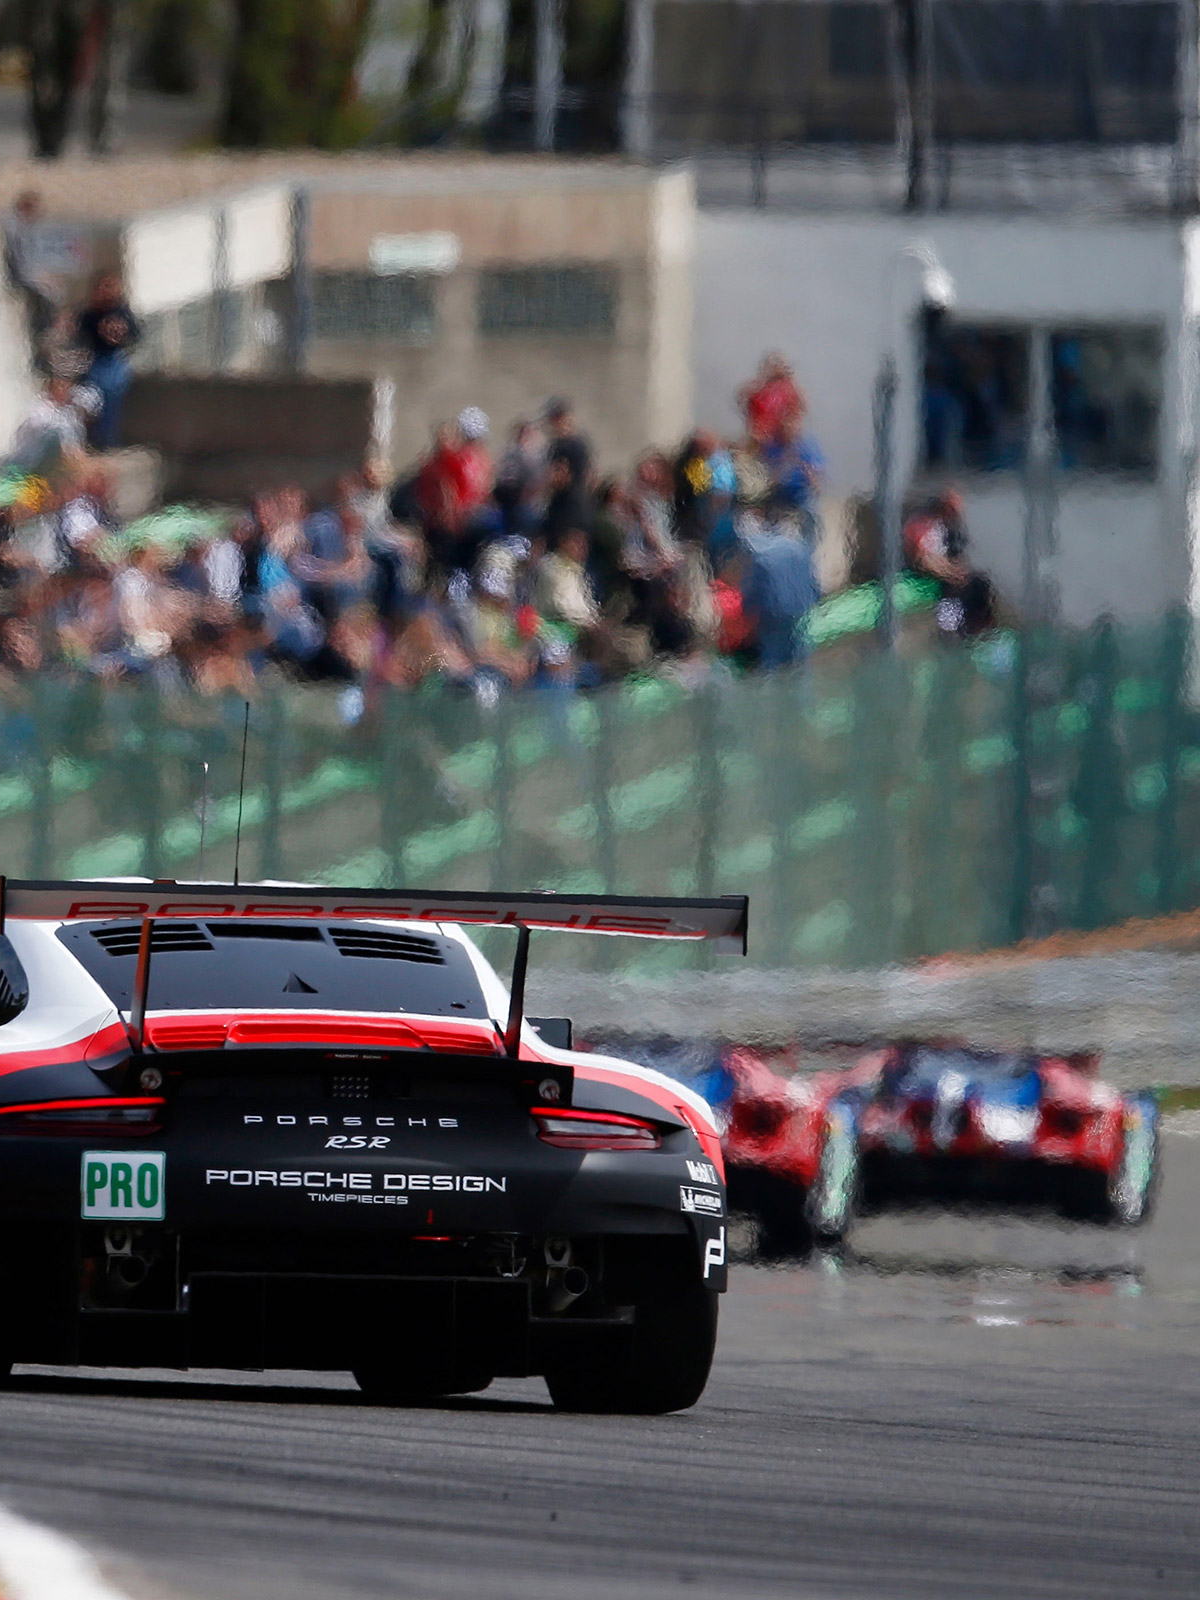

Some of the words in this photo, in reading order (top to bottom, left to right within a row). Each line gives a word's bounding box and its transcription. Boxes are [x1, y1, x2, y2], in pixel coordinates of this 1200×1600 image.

[66, 902, 672, 936] PORSCHE
[243, 1114, 459, 1128] PORSCHE
[324, 1135, 392, 1150] RSR
[87, 1161, 159, 1209] PRO
[205, 1169, 373, 1189] PORSCHE
[383, 1173, 507, 1193] DESIGN
[307, 1192, 409, 1205] TIMEPIECES
